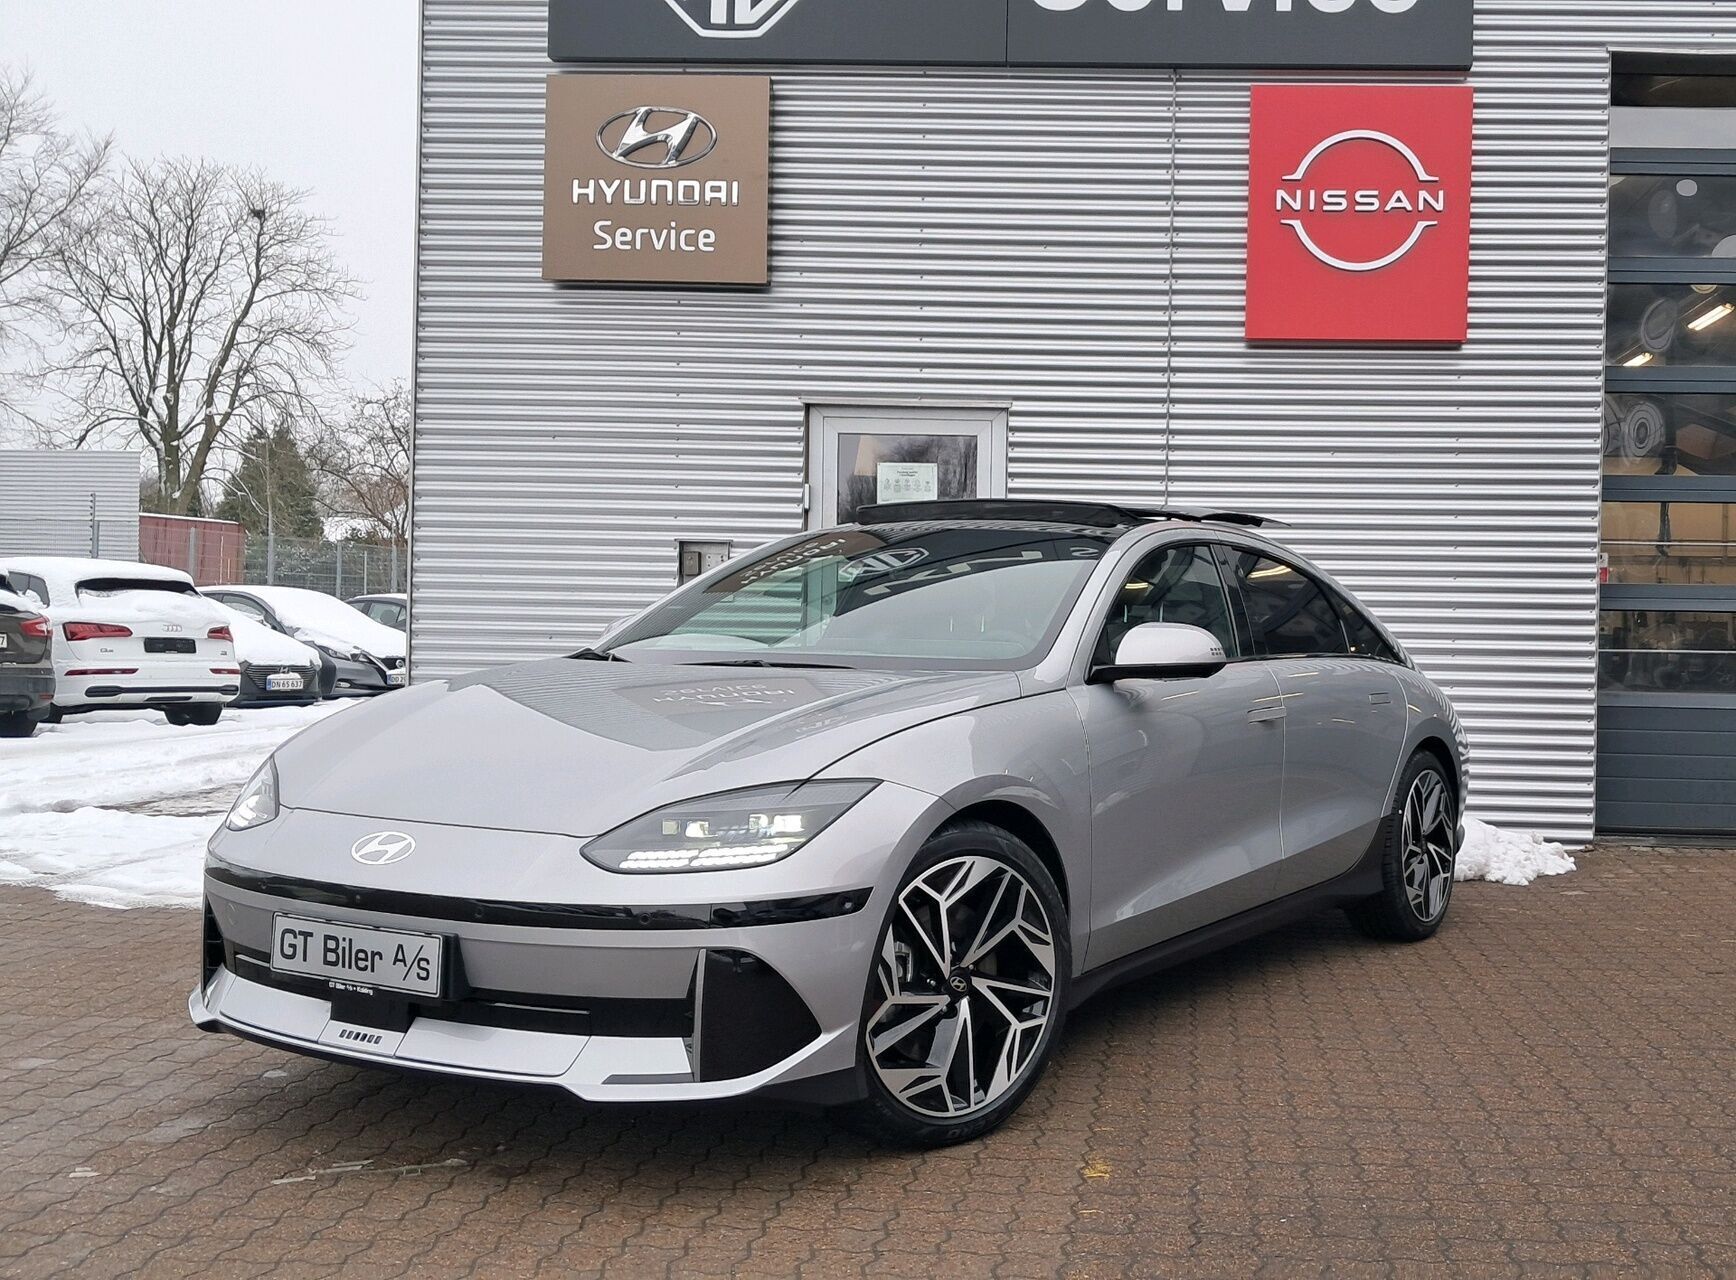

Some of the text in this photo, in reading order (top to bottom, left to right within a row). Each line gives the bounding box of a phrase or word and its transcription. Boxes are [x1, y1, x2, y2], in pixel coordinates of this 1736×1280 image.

[572, 179, 739, 206] HYUNDAI
[1276, 189, 1444, 212] NISSAN
[593, 220, 716, 252] Service
[280, 927, 431, 982] GT Biler A/S
